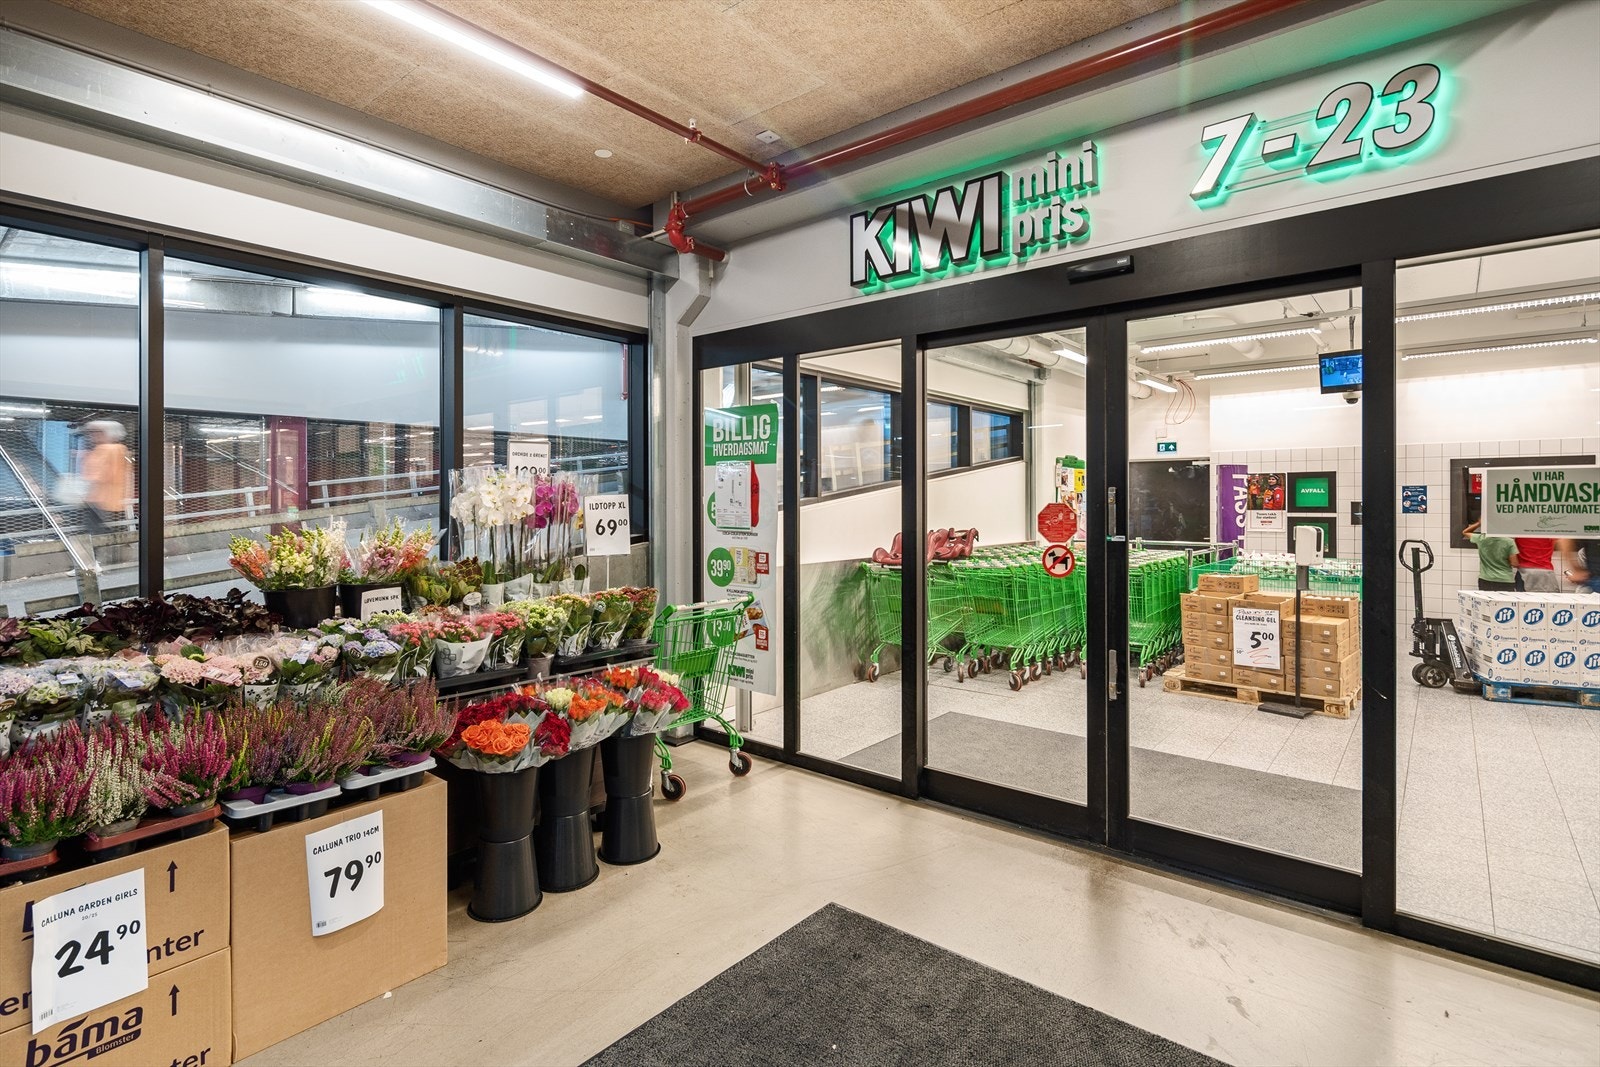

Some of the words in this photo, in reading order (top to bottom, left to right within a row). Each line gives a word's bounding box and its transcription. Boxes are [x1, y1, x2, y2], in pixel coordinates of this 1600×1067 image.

[850, 171, 1004, 287] KIWI
[1012, 140, 1097, 202] mini
[1012, 196, 1090, 256] pris
[713, 414, 771, 442] BILLIG
[713, 441, 769, 457] HVERDAGSMAT
[1533, 472, 1542, 480] VI
[1545, 471, 1565, 480] HAR
[589, 502, 616, 510] ILDTOPP
[618, 501, 626, 509] XL
[1496, 504, 1514, 513] VED
[595, 519, 617, 536] 69
[710, 559, 723, 577] 39
[1497, 609, 1512, 622] Jif
[1525, 610, 1541, 623] Jif
[1554, 611, 1570, 624] Jif
[1250, 631, 1261, 649] 5
[1262, 632, 1274, 641] 00
[1499, 650, 1514, 663] Jif
[1527, 652, 1542, 664] Jif
[1557, 653, 1573, 666] Jif
[313, 838, 343, 855] CALLUNA
[345, 832, 361, 843] TRIO
[363, 825, 379, 837] 14CM
[324, 860, 364, 898] 79
[365, 851, 381, 868] 90
[41, 908, 75, 928] CALLUNA
[79, 897, 112, 912] GARDEN
[115, 888, 138, 902] GIRLS
[81, 913, 98, 921] 20/25
[55, 930, 115, 978] 24
[116, 920, 141, 940] 90
[95, 1033, 135, 1055] Blomster
